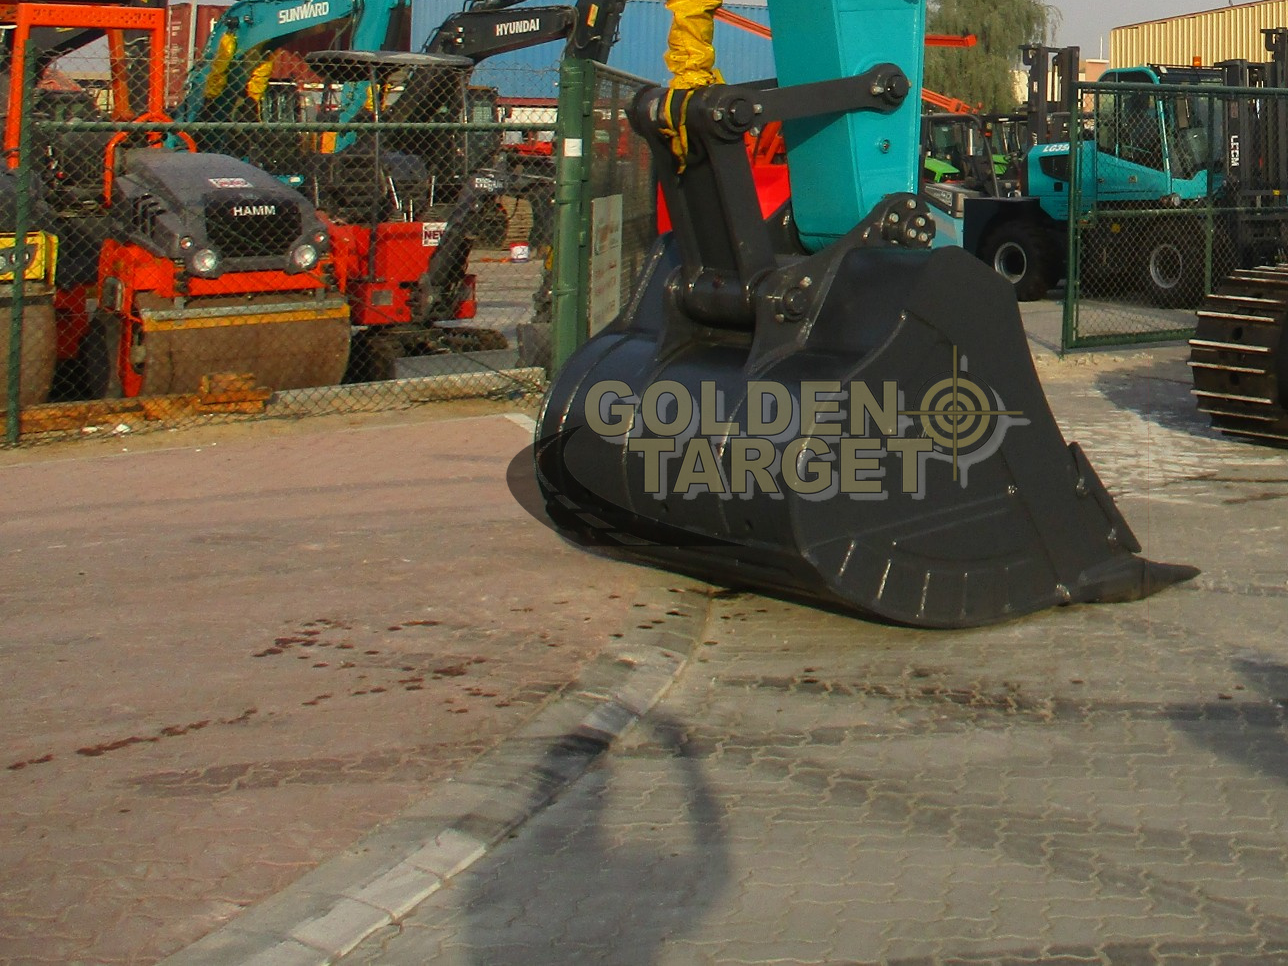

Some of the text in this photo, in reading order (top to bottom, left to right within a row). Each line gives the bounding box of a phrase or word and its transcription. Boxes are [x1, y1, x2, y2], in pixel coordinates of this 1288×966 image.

[277, 0, 330, 24] SUNWARD
[495, 17, 540, 37] HYUNDAI
[233, 205, 276, 217] HAMM
